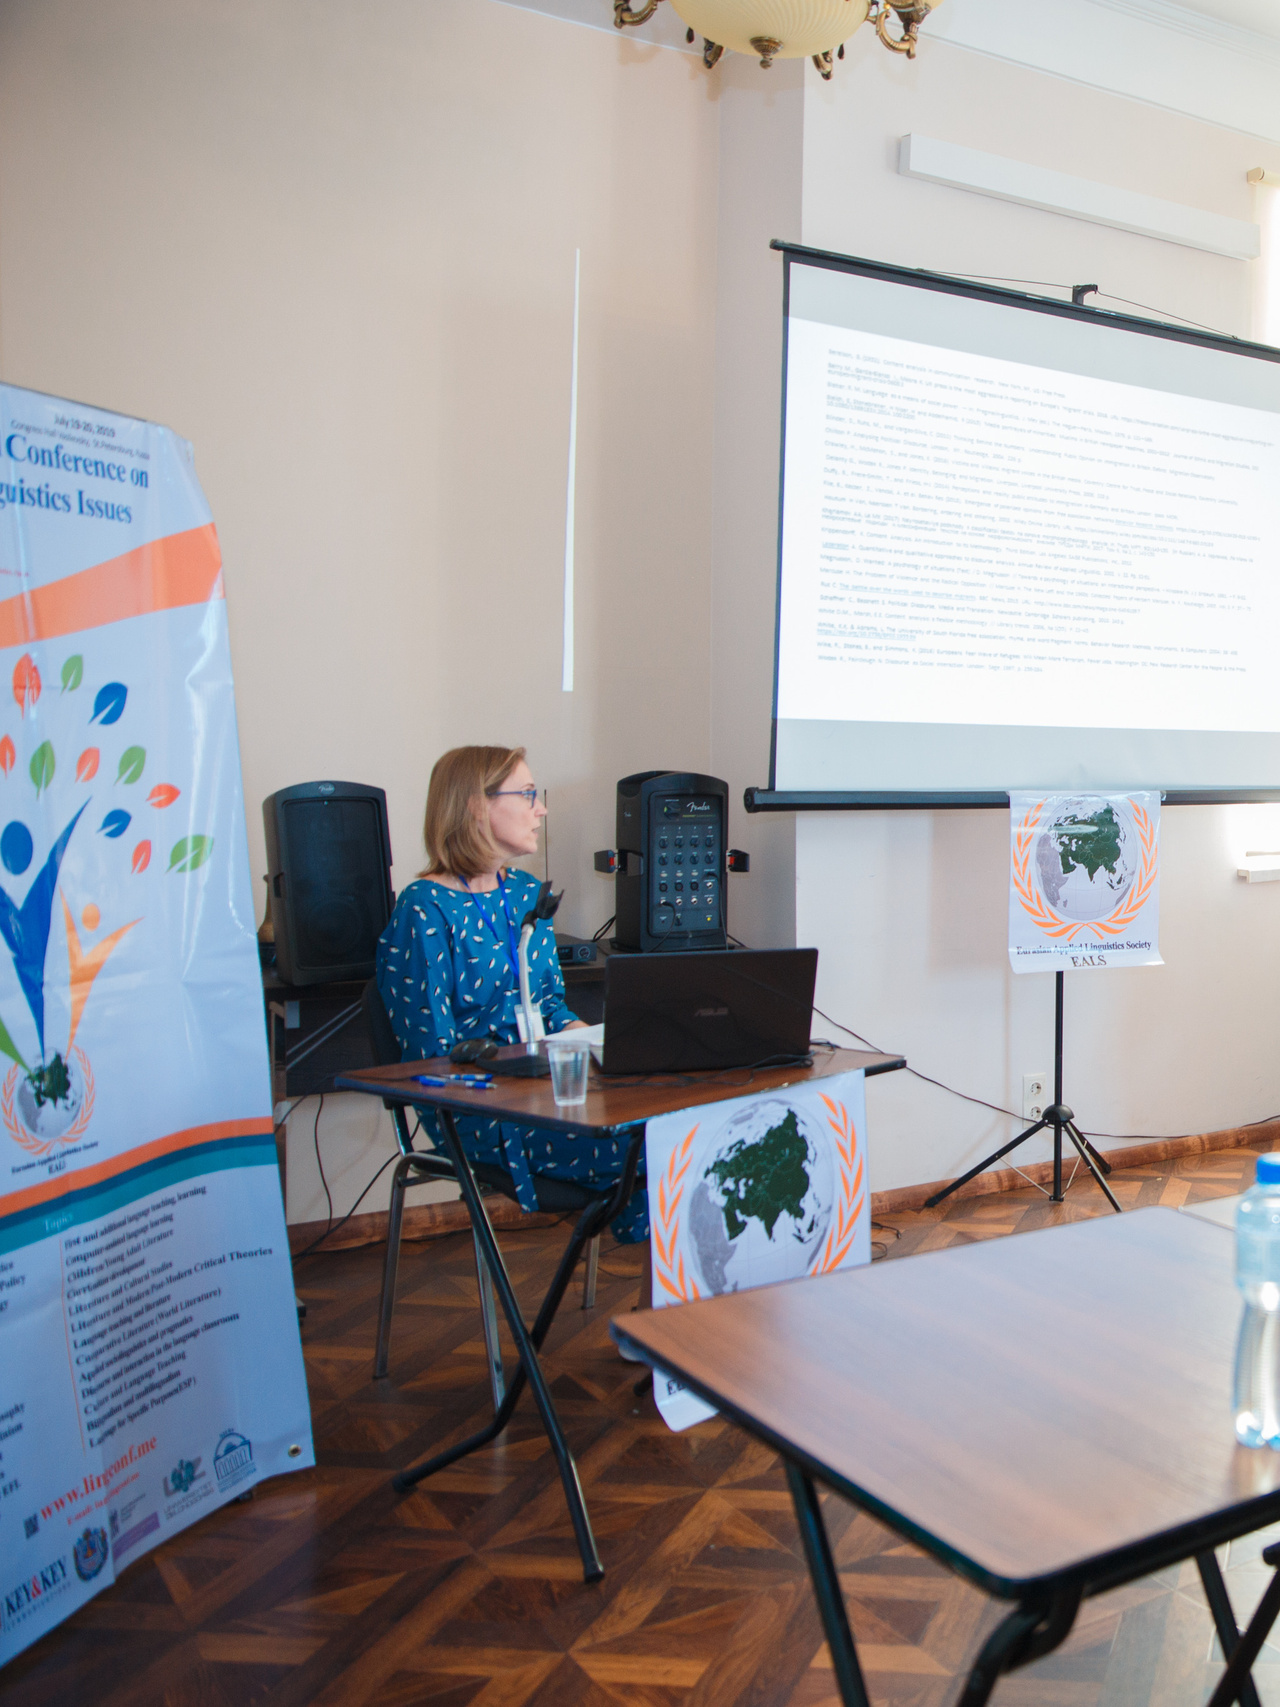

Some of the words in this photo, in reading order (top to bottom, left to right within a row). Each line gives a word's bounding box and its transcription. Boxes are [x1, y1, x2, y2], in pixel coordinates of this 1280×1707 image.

[5, 433, 127, 483] Conference
[130, 467, 149, 489] on
[76, 489, 132, 524] Issues
[1053, 943, 1083, 956] Applied
[1084, 941, 1125, 953] Linguistics
[1126, 940, 1152, 951] Society
[1070, 955, 1107, 968] EALS
[194, 1255, 226, 1273] Critical
[229, 1247, 273, 1262] Theories
[180, 1287, 222, 1313] Literature)
[4, 1556, 67, 1618] KEY&KEY
